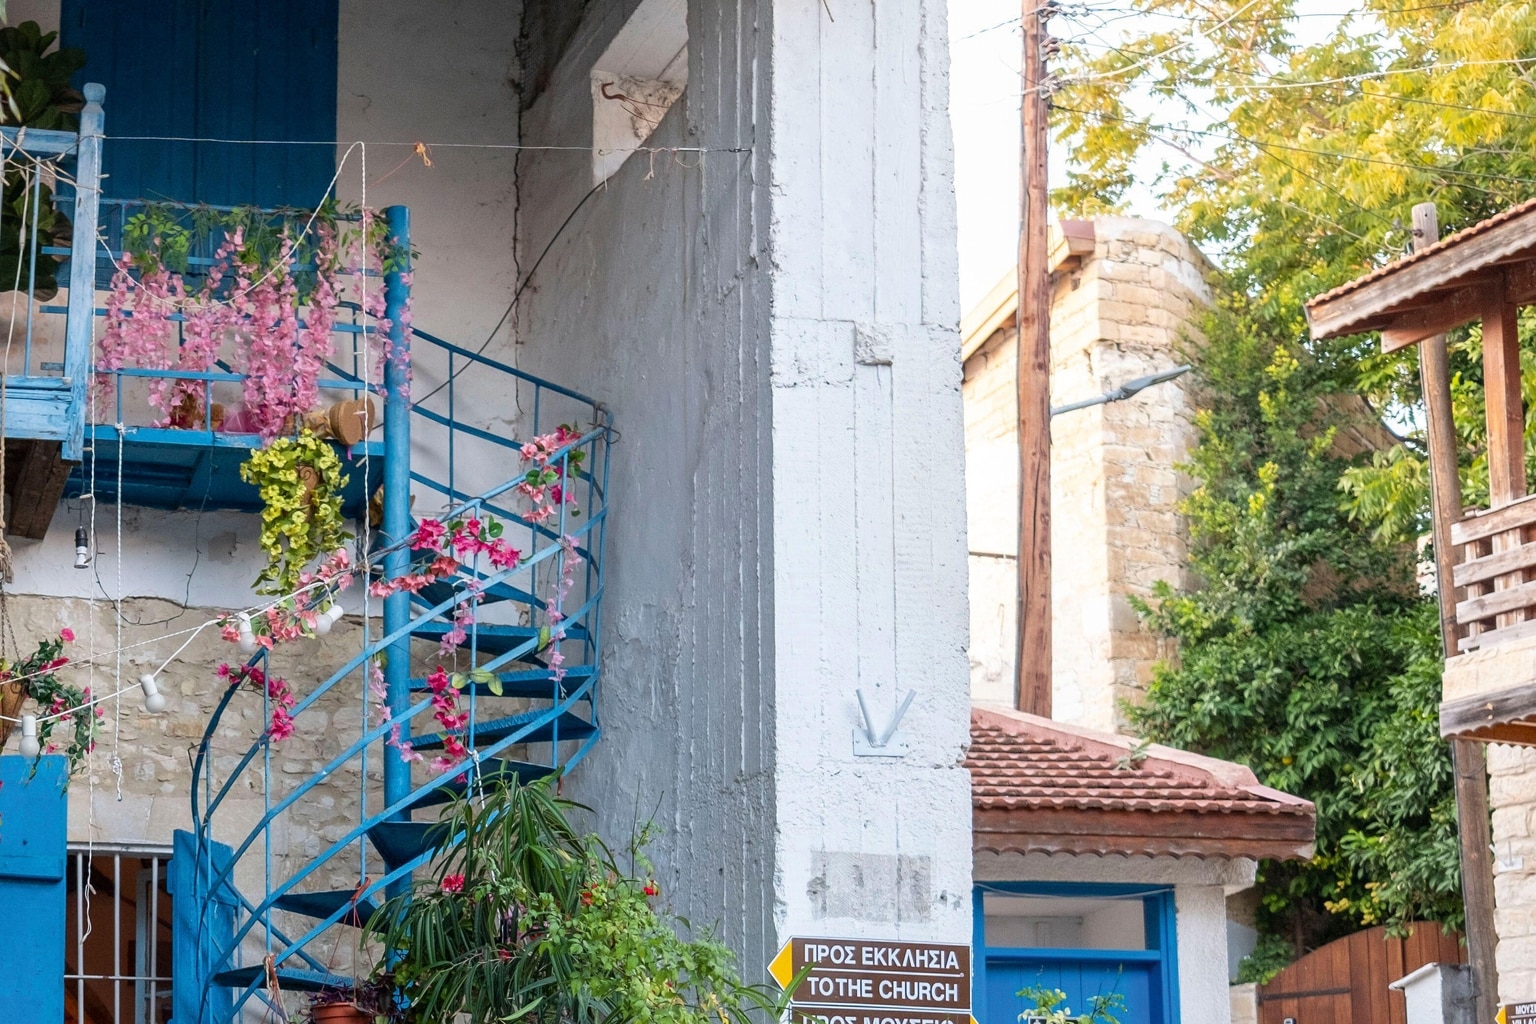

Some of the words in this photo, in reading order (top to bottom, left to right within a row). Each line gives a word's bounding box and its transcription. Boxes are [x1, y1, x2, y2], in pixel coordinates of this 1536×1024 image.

[804, 943, 856, 965] ΠΡΟΣ
[861, 946, 960, 970] ΕΚΚΛΗΣΙΑ
[807, 977, 835, 996] TO
[835, 978, 873, 998] THE
[878, 982, 959, 1002] CHURCH
